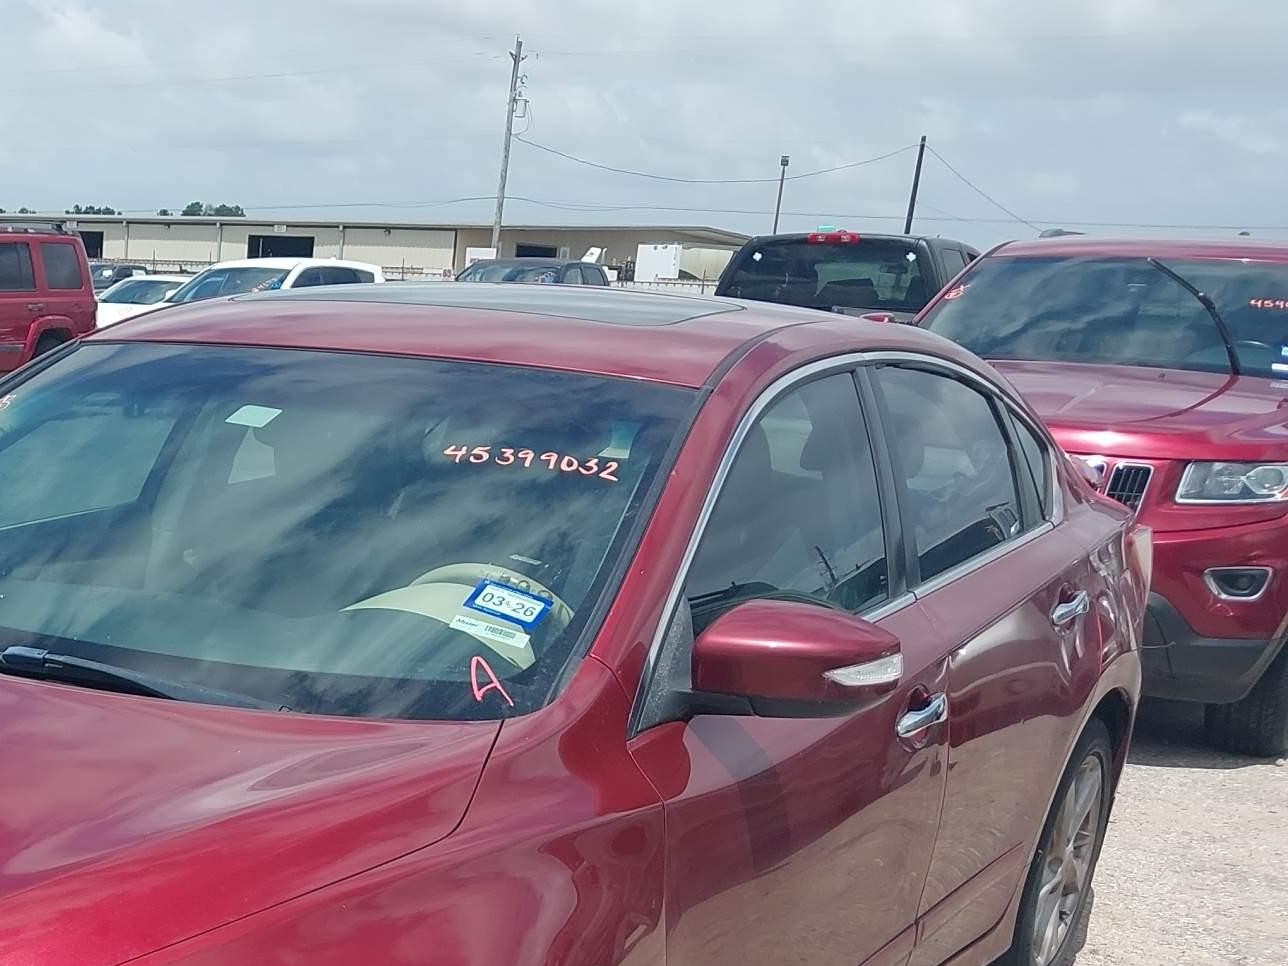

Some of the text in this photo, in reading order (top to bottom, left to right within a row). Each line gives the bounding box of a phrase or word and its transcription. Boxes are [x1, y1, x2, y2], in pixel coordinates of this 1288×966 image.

[443, 444, 619, 482] 45399032
[481, 592, 505, 607] 03
[511, 602, 537, 617] 26
[470, 655, 515, 707] A
